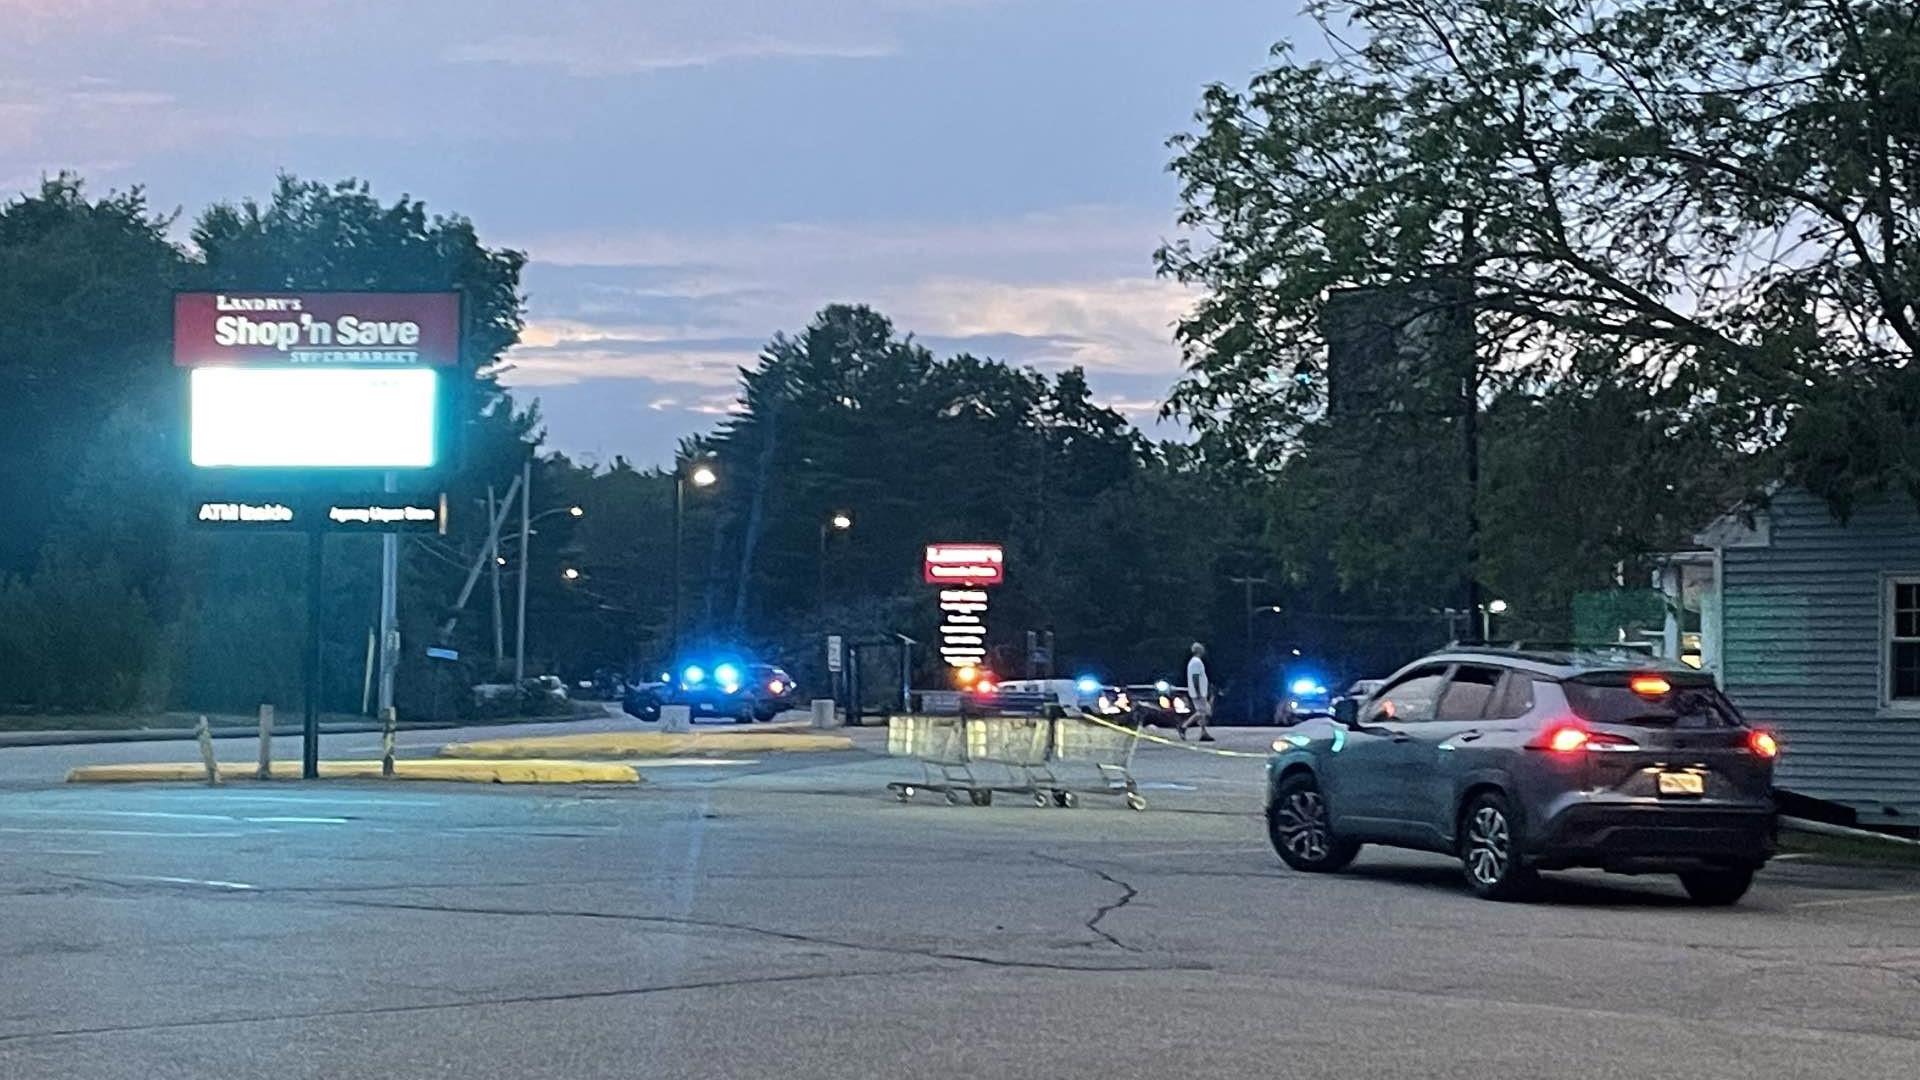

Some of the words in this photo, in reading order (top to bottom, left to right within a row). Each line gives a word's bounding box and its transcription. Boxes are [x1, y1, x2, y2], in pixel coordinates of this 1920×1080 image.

[216, 295, 303, 311] LANDRY'S
[336, 315, 419, 346] Save
[290, 351, 419, 363] SUPERMARKET
[199, 504, 239, 521] ATM
